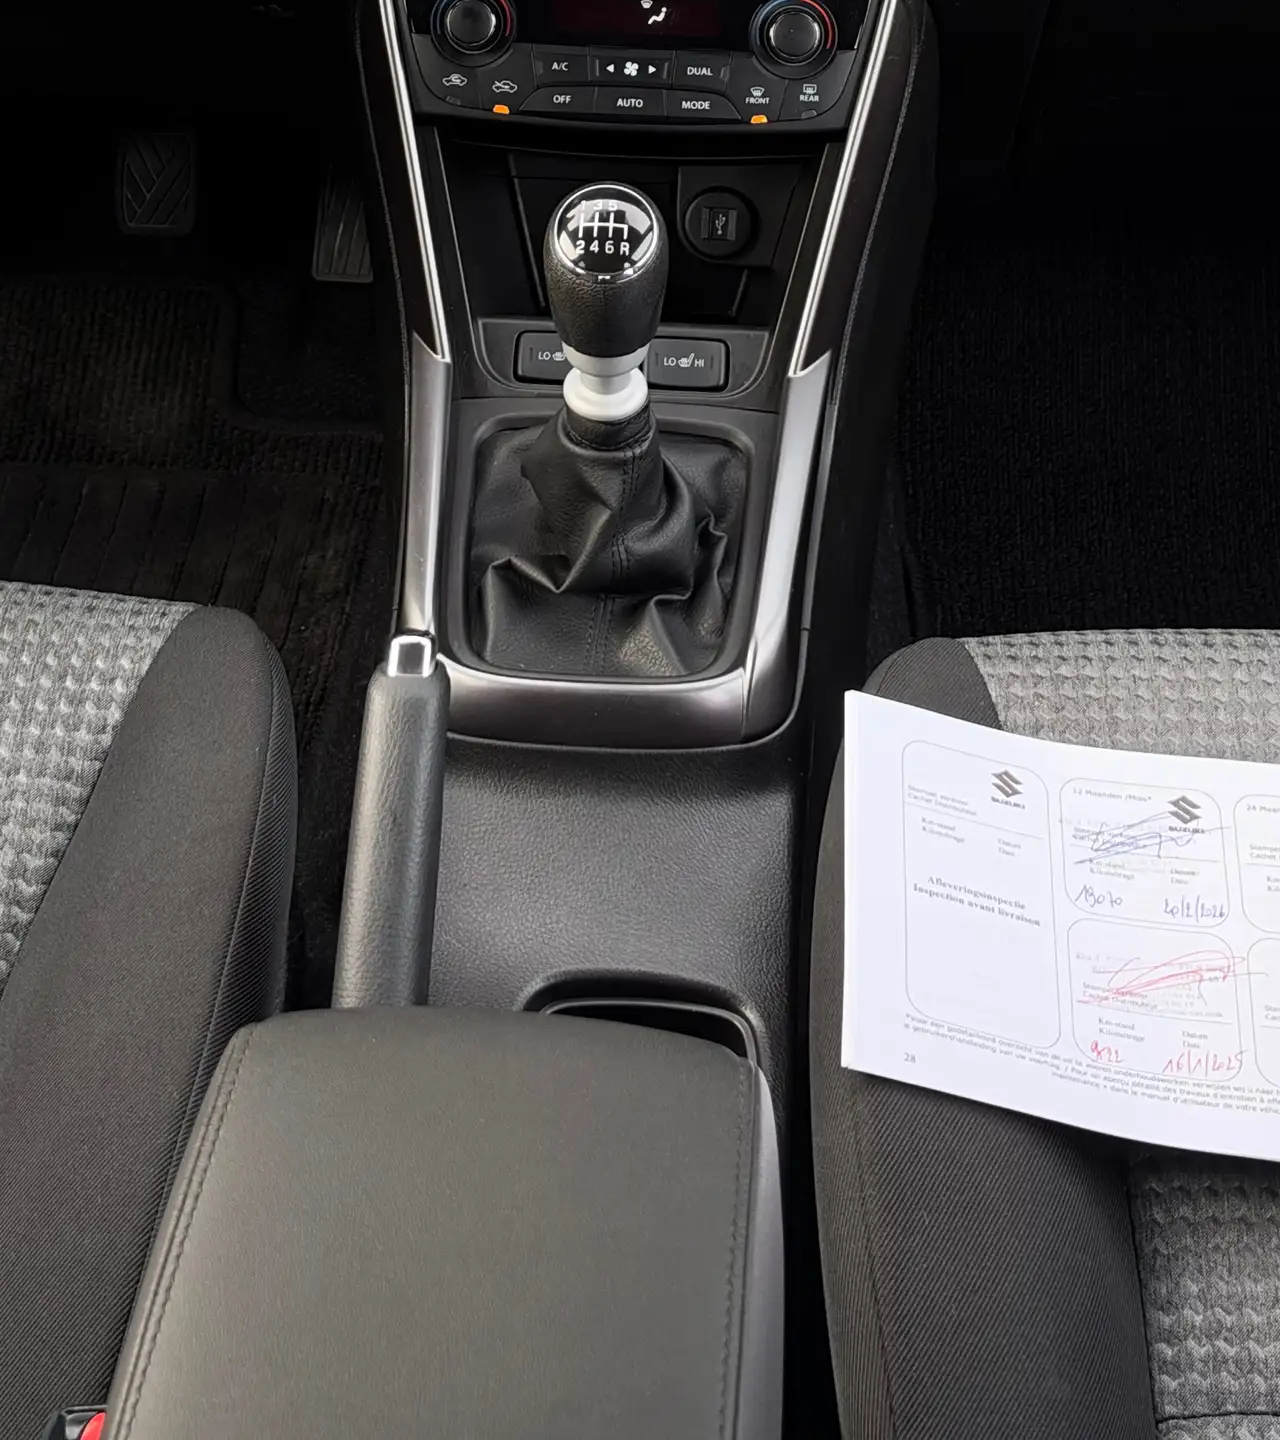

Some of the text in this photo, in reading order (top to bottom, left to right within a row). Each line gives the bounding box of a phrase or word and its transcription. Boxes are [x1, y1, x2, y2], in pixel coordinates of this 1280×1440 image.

[552, 62, 569, 72] A/C
[687, 66, 713, 76] DUAL
[553, 95, 571, 104] OFF
[616, 98, 644, 108] AUTO
[746, 97, 770, 105] FRONT
[800, 94, 819, 102] REAR
[682, 101, 711, 110] MODE
[594, 200, 603, 210] 3
[608, 200, 618, 211] 5
[576, 240, 630, 256] 2 4 6 R
[538, 352, 551, 360] LO
[664, 357, 705, 368] LO HI
[913, 883, 965, 905] Inspection
[998, 908, 1041, 927] livraison
[904, 1052, 916, 1063] 28
